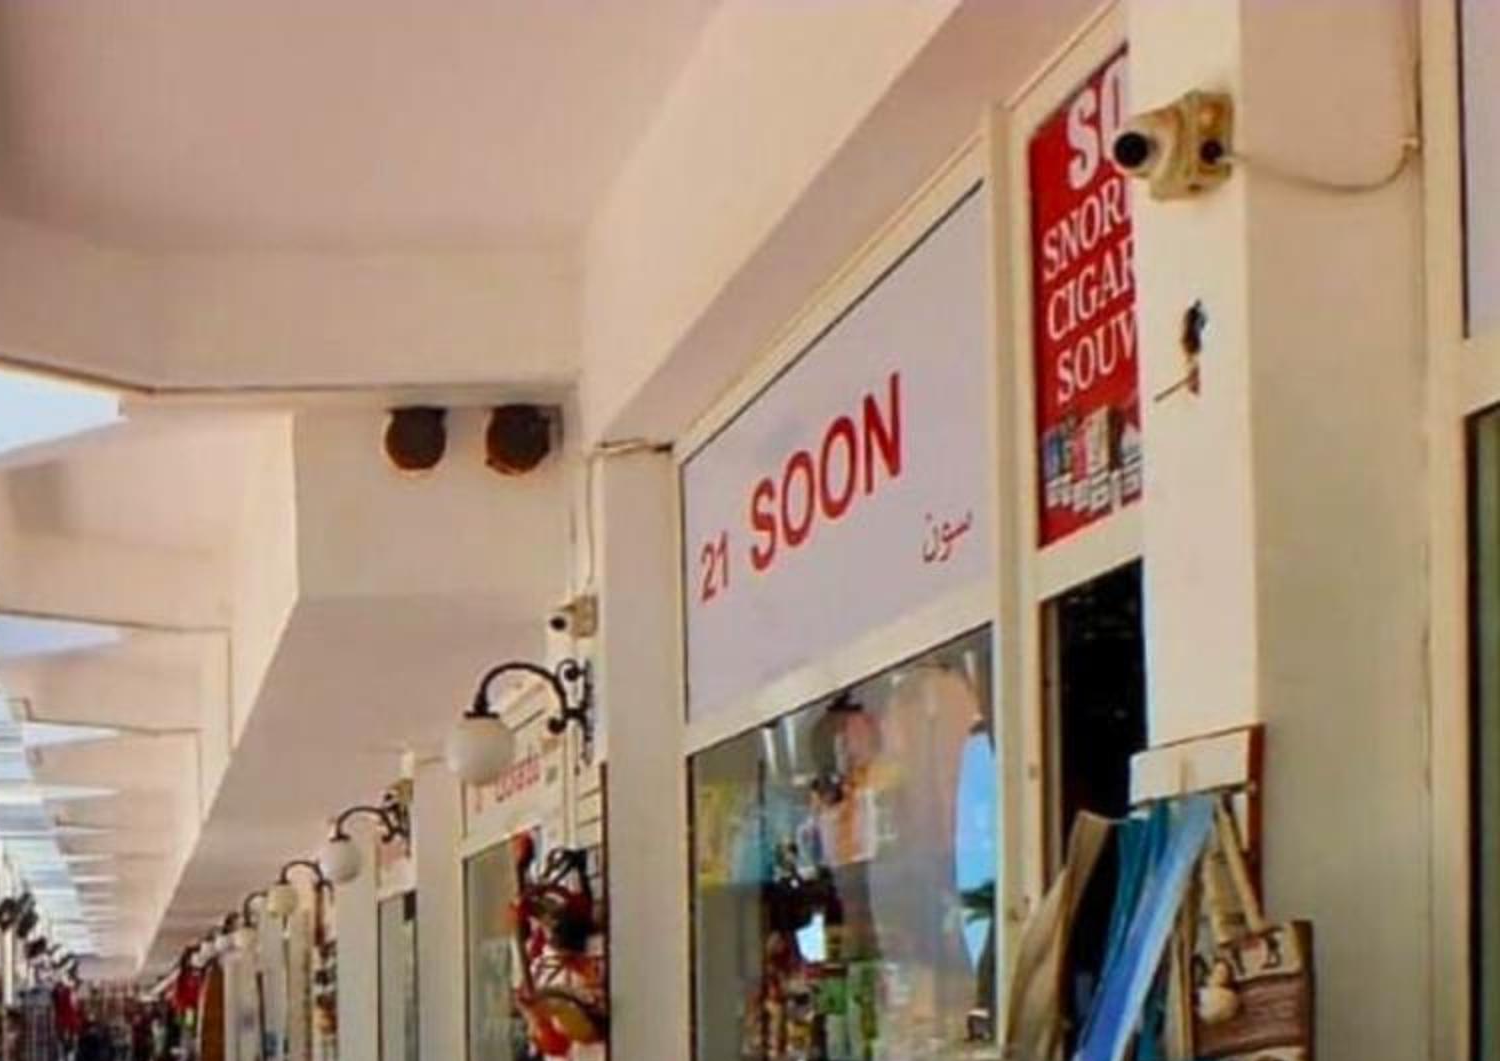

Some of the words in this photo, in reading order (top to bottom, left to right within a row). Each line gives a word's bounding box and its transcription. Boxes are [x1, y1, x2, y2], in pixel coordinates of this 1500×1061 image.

[700, 530, 728, 602] 21
[750, 371, 901, 572] SOON
[921, 508, 973, 562] سون
